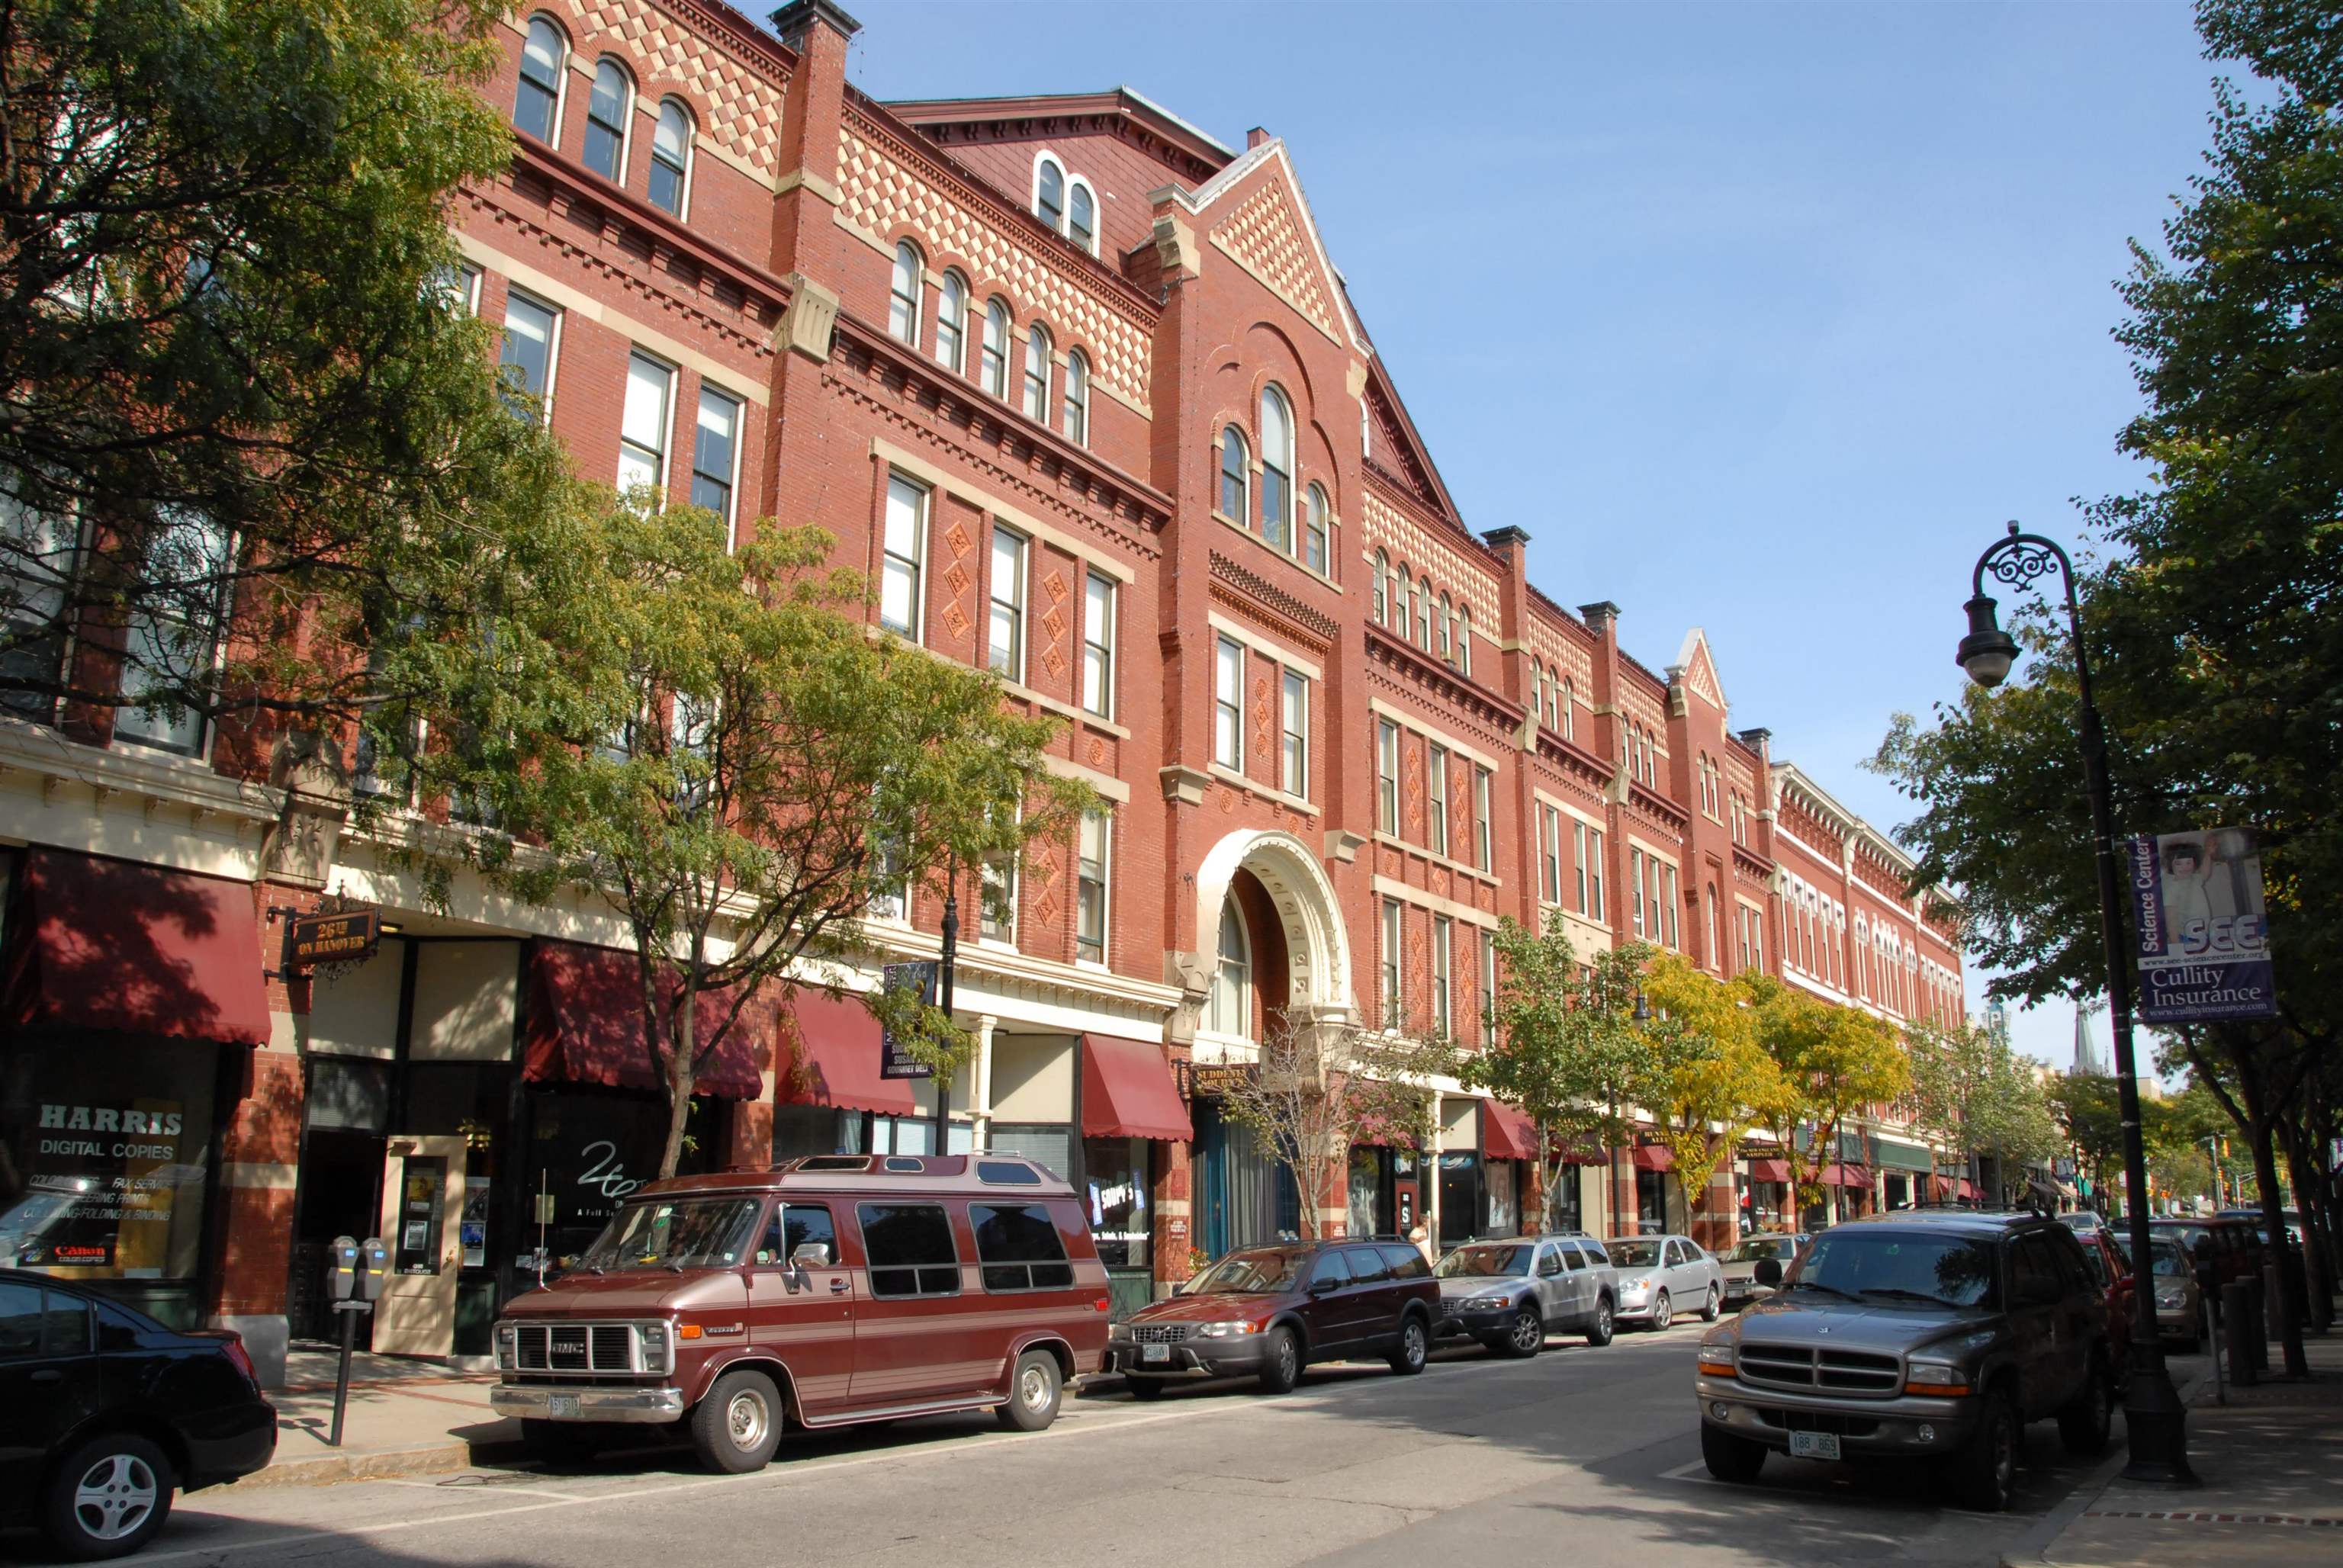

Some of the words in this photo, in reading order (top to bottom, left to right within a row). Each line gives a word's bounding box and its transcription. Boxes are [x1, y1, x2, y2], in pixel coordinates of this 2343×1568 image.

[2136, 838, 2153, 888] Center
[2142, 892, 2158, 953] Science
[2184, 914, 2261, 954] SEE
[299, 943, 312, 955] ON
[315, 936, 365, 953] HANOVER
[2150, 966, 2224, 988] Cullity
[2152, 986, 2261, 1007] Insurance
[2149, 1001, 2267, 1018] www.cullityinsurance.com
[39, 1104, 182, 1136] HARRIS
[40, 1139, 104, 1157] DIGITAL
[112, 1143, 173, 1160] COPIES
[112, 1178, 132, 1189] FAX
[116, 1193, 150, 1204] PRINTS
[124, 1210, 132, 1219] &
[133, 1209, 172, 1221] BINDING
[54, 1245, 105, 1256] Canon
[551, 1342, 585, 1354] GMC
